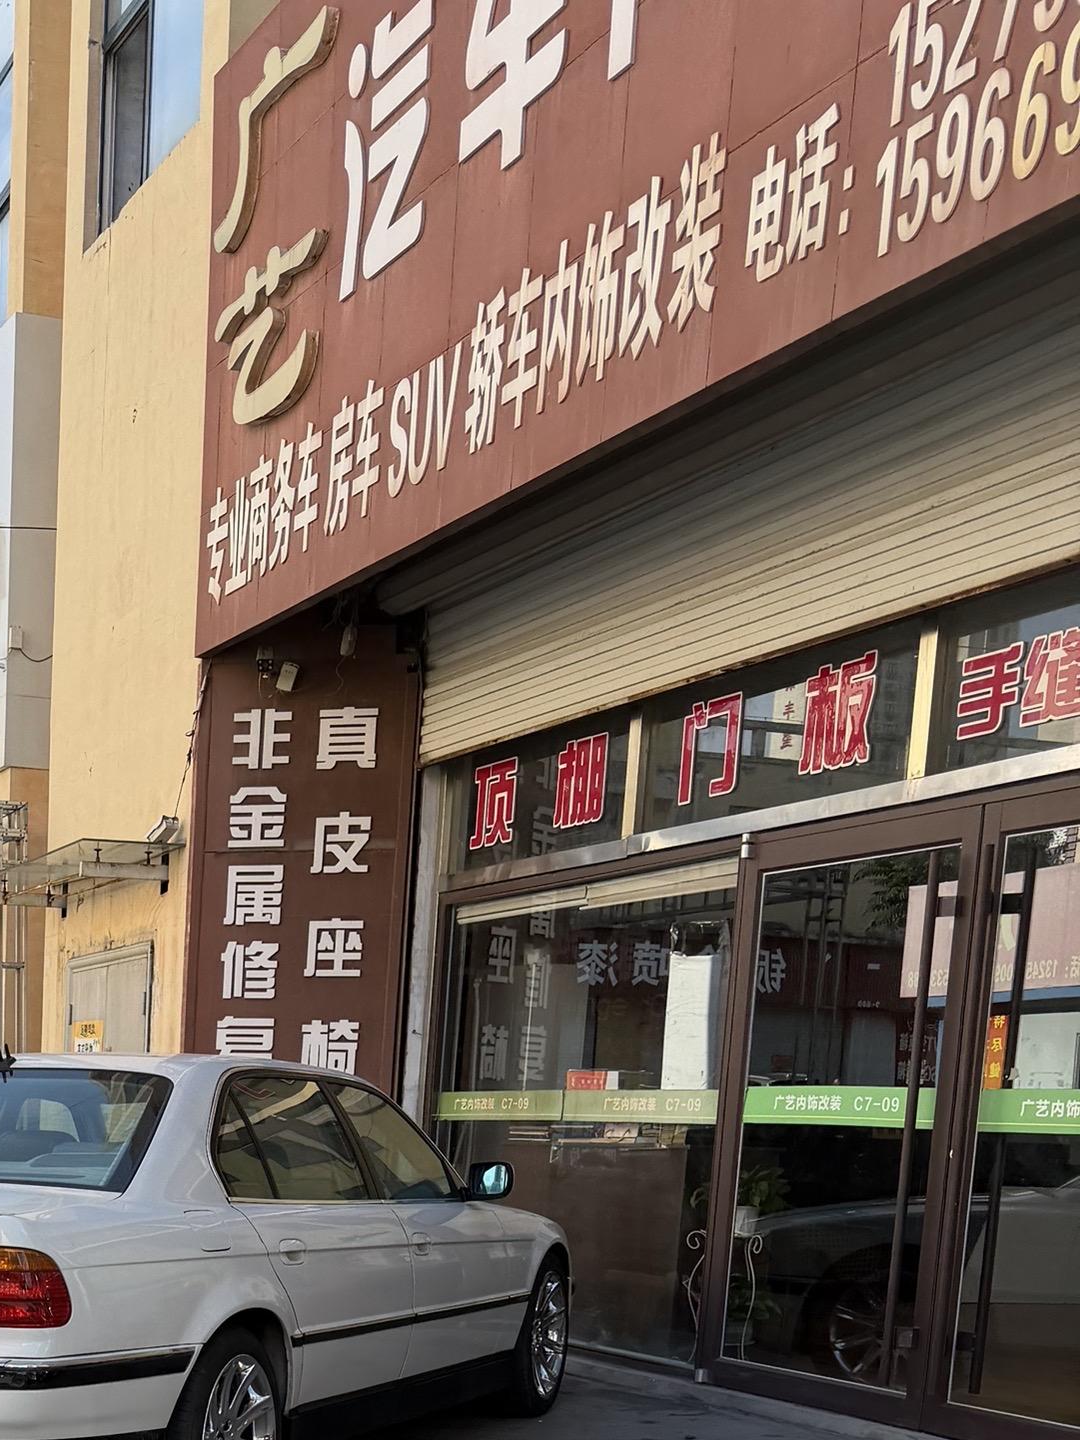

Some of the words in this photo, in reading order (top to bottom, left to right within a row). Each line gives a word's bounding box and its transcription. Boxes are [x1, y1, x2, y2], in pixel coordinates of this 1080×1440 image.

[339, 0, 634, 303] 汽车
[206, 421, 324, 606] 专业商务车
[323, 379, 386, 537] 房车
[387, 341, 463, 498] SUV
[464, 131, 727, 455] 轿车内饰改装
[469, 732, 610, 850] 顶棚
[676, 649, 878, 806] 门板
[956, 626, 1080, 741] 手缝
[215, 708, 294, 1060] 非金属修复
[300, 706, 380, 1076] 真皮座椅
[501, 1097, 529, 1109] C7-09
[665, 1098, 701, 1111] C7-09
[773, 1095, 842, 1111] 广艺内饰改装
[853, 1096, 900, 1112] C7-09
[1020, 1099, 1080, 1118] 广艺内饰
